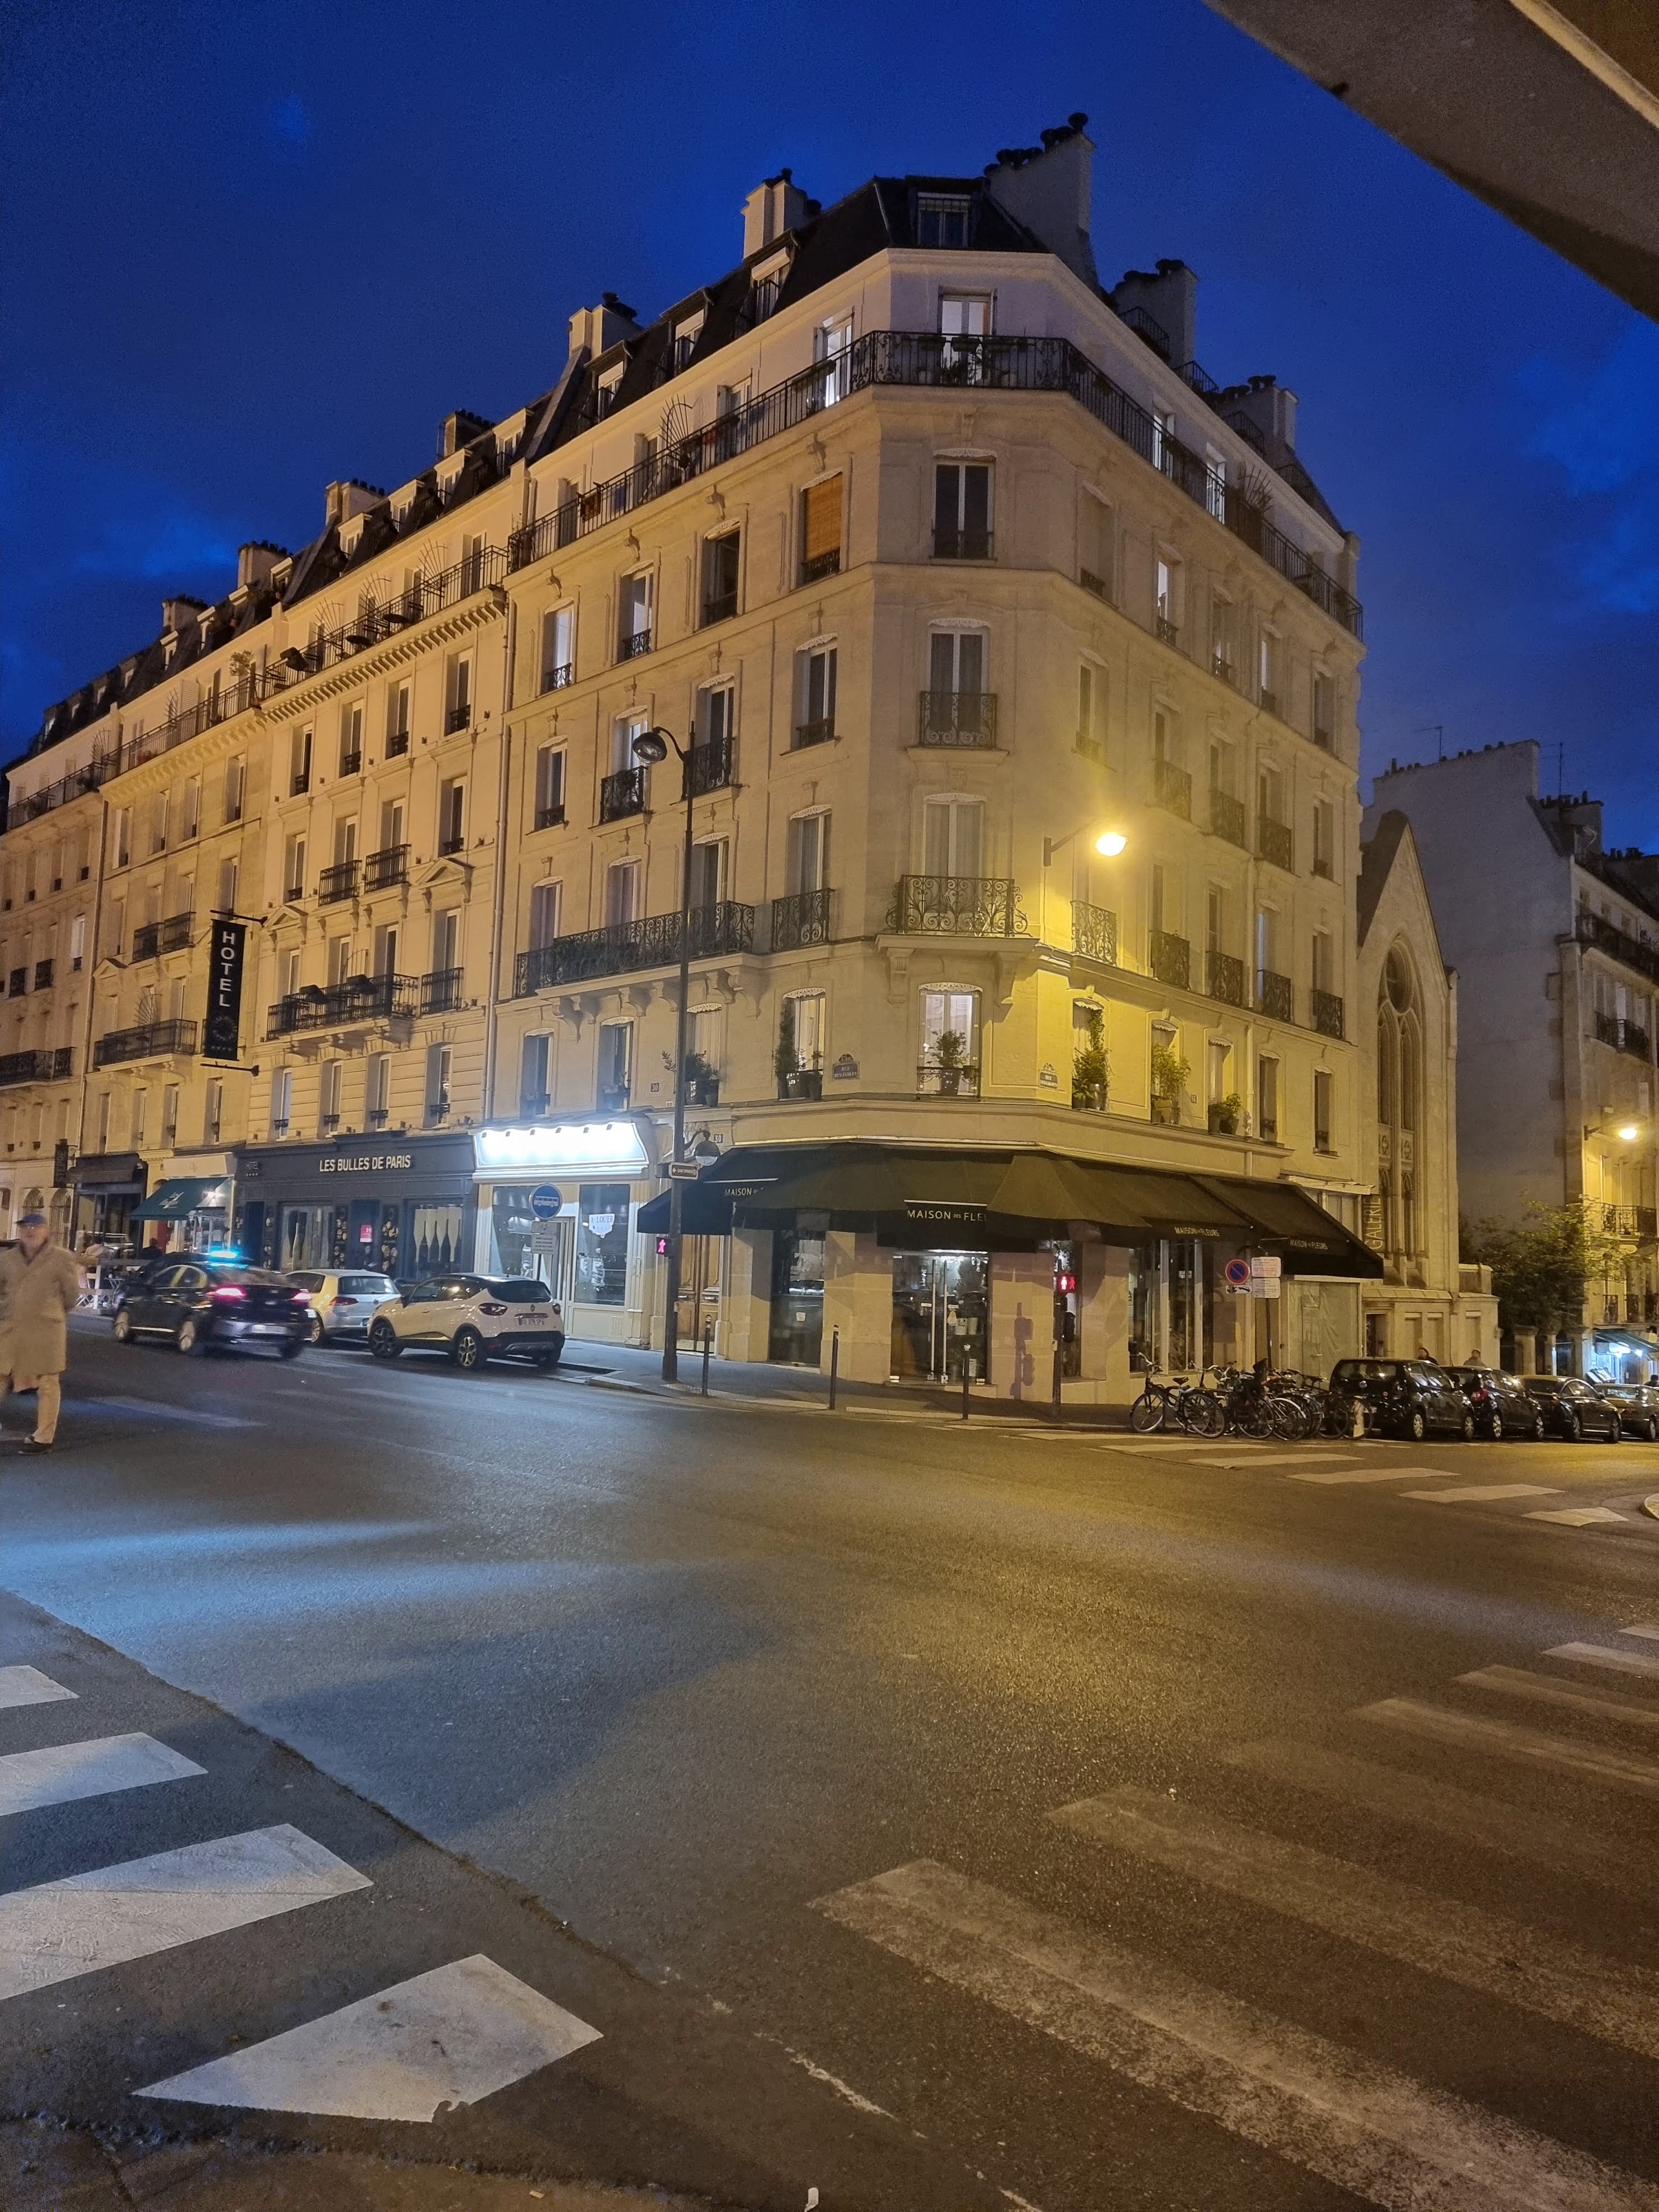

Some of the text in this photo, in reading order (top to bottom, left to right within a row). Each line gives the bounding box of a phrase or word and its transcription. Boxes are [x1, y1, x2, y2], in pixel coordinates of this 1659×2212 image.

[219, 931, 235, 1007] HOTEL
[714, 1135, 721, 1143] 30
[319, 1155, 411, 1172] LES BULLES DE PARIS
[724, 1188, 752, 1197] MAISON
[907, 1209, 951, 1220] MAISON
[1200, 1228, 1220, 1237] FLEURS
[1290, 1239, 1307, 1248] MAISON
[1311, 1241, 1328, 1250] FLEURS
